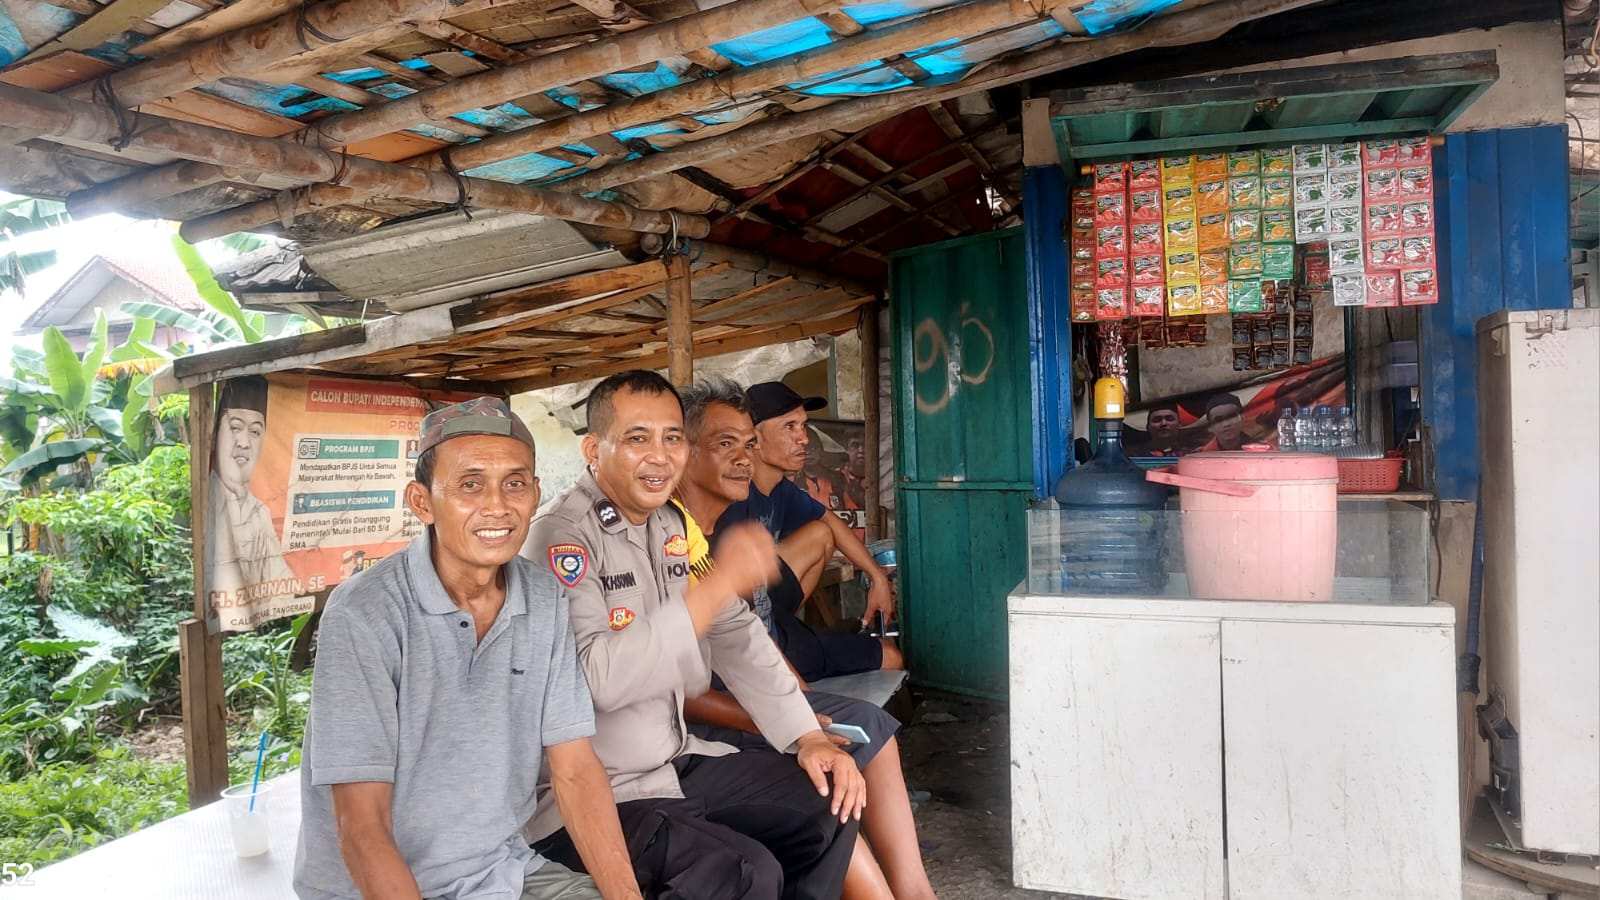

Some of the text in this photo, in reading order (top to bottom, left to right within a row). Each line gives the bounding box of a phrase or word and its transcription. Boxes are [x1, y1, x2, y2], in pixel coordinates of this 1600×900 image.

[311, 391, 340, 403] CALON
[342, 392, 371, 406] BUPATI
[324, 445, 359, 454] PROGRAM
[341, 463, 358, 471] BPJS
[375, 462, 397, 471] Semua
[292, 519, 331, 529] Pendidikan
[332, 517, 352, 526] Gratis
[332, 527, 352, 536] Mulai
[353, 526, 366, 534] Dari
[367, 525, 376, 533] SD
[289, 541, 307, 550] SMA
[308, 575, 327, 591] SE
